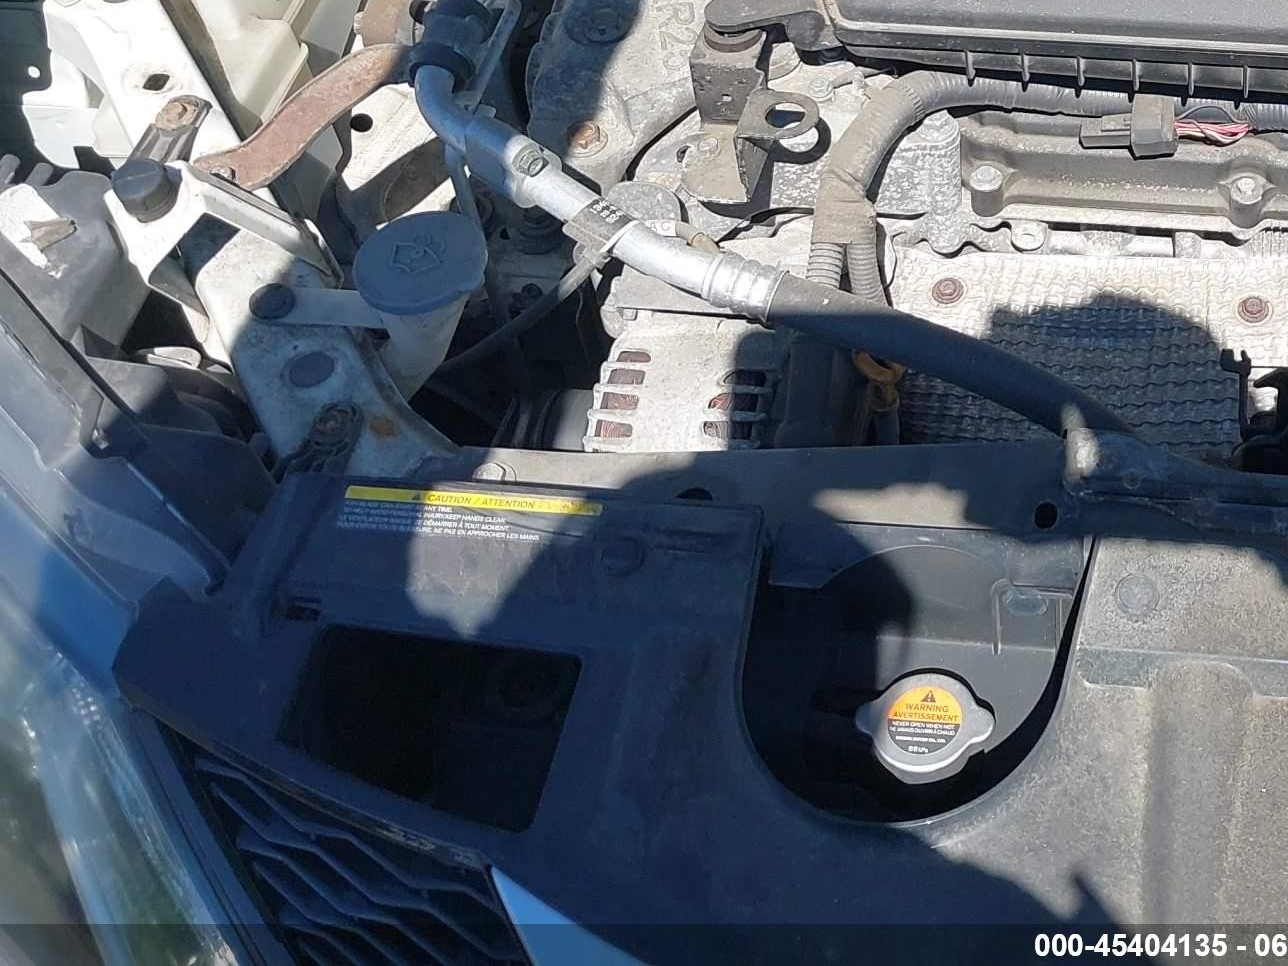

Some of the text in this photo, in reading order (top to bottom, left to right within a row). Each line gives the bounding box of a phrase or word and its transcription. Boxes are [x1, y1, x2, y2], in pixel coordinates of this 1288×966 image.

[428, 494, 472, 504] CAUTION
[482, 498, 535, 509] ATTENTION
[906, 702, 950, 713] WARNING
[893, 711, 959, 722] AVERTISSEMENT
